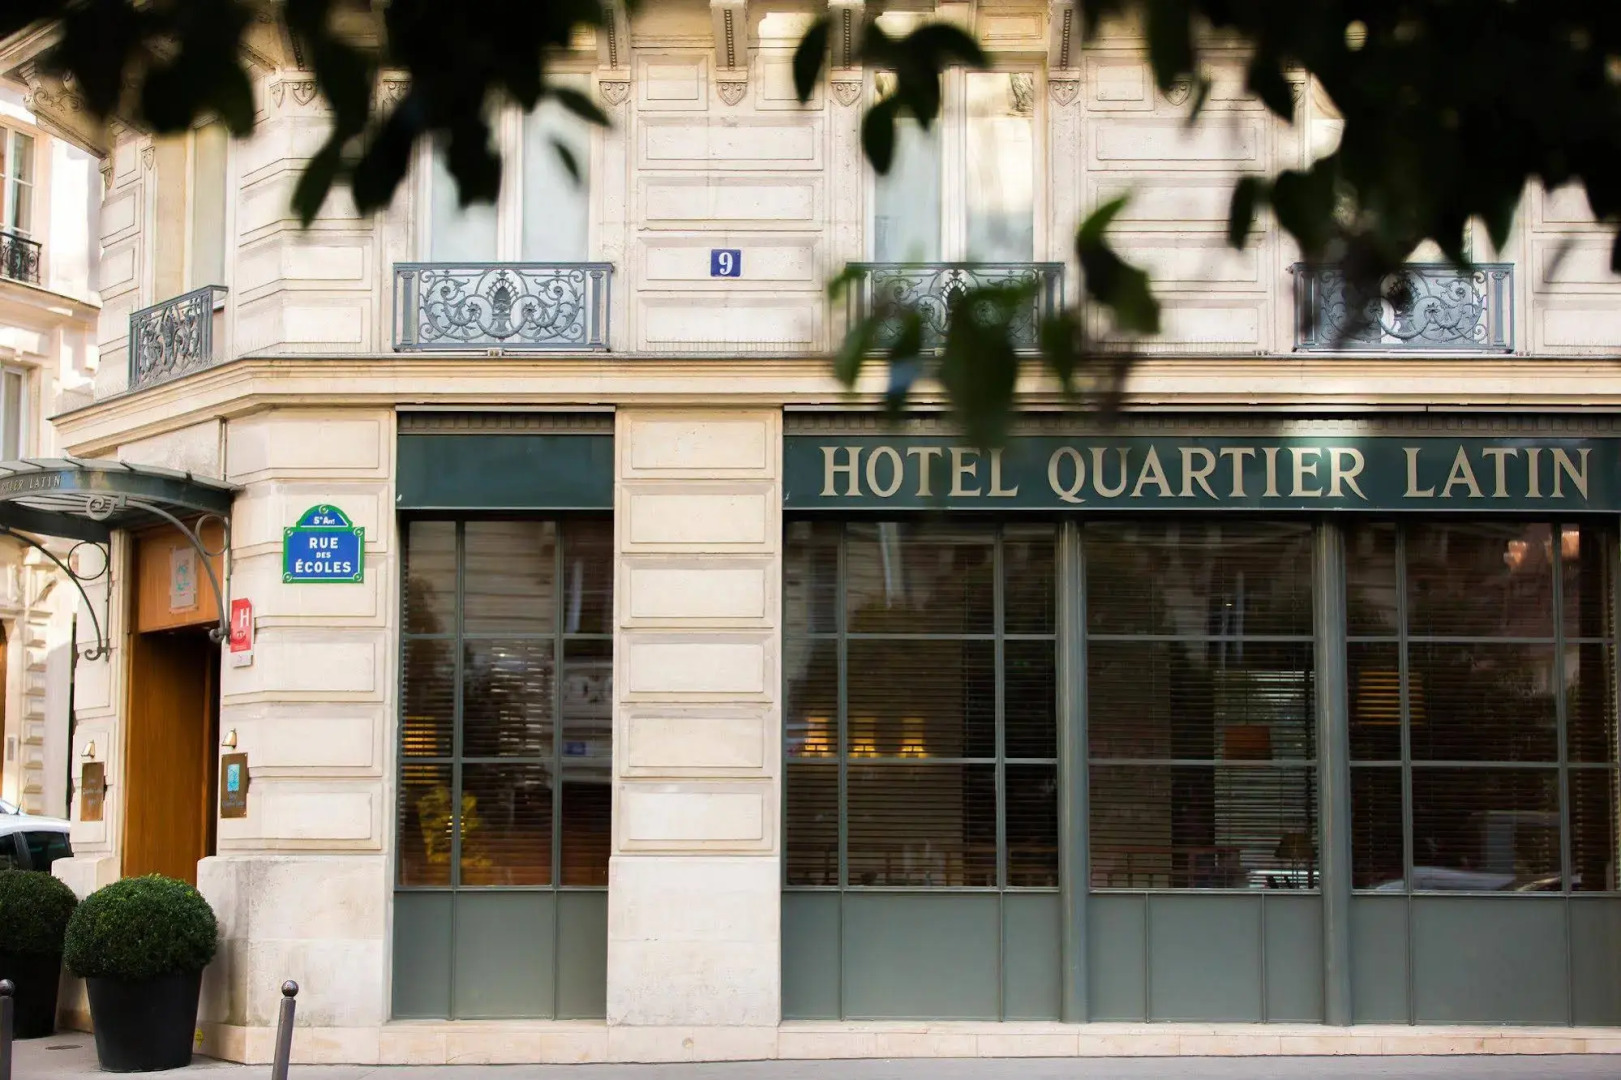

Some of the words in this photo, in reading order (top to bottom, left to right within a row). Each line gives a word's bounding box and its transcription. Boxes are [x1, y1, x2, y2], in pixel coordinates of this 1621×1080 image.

[719, 252, 733, 275] 9
[819, 446, 1019, 498] HOTEL
[1047, 444, 1369, 503] QUARTIER
[1402, 444, 1593, 500] LATIN
[29, 474, 62, 489] LATIN
[309, 537, 339, 549] RUE
[315, 551, 332, 559] DES
[295, 558, 352, 573] ÉCOLES
[239, 607, 250, 628] H
